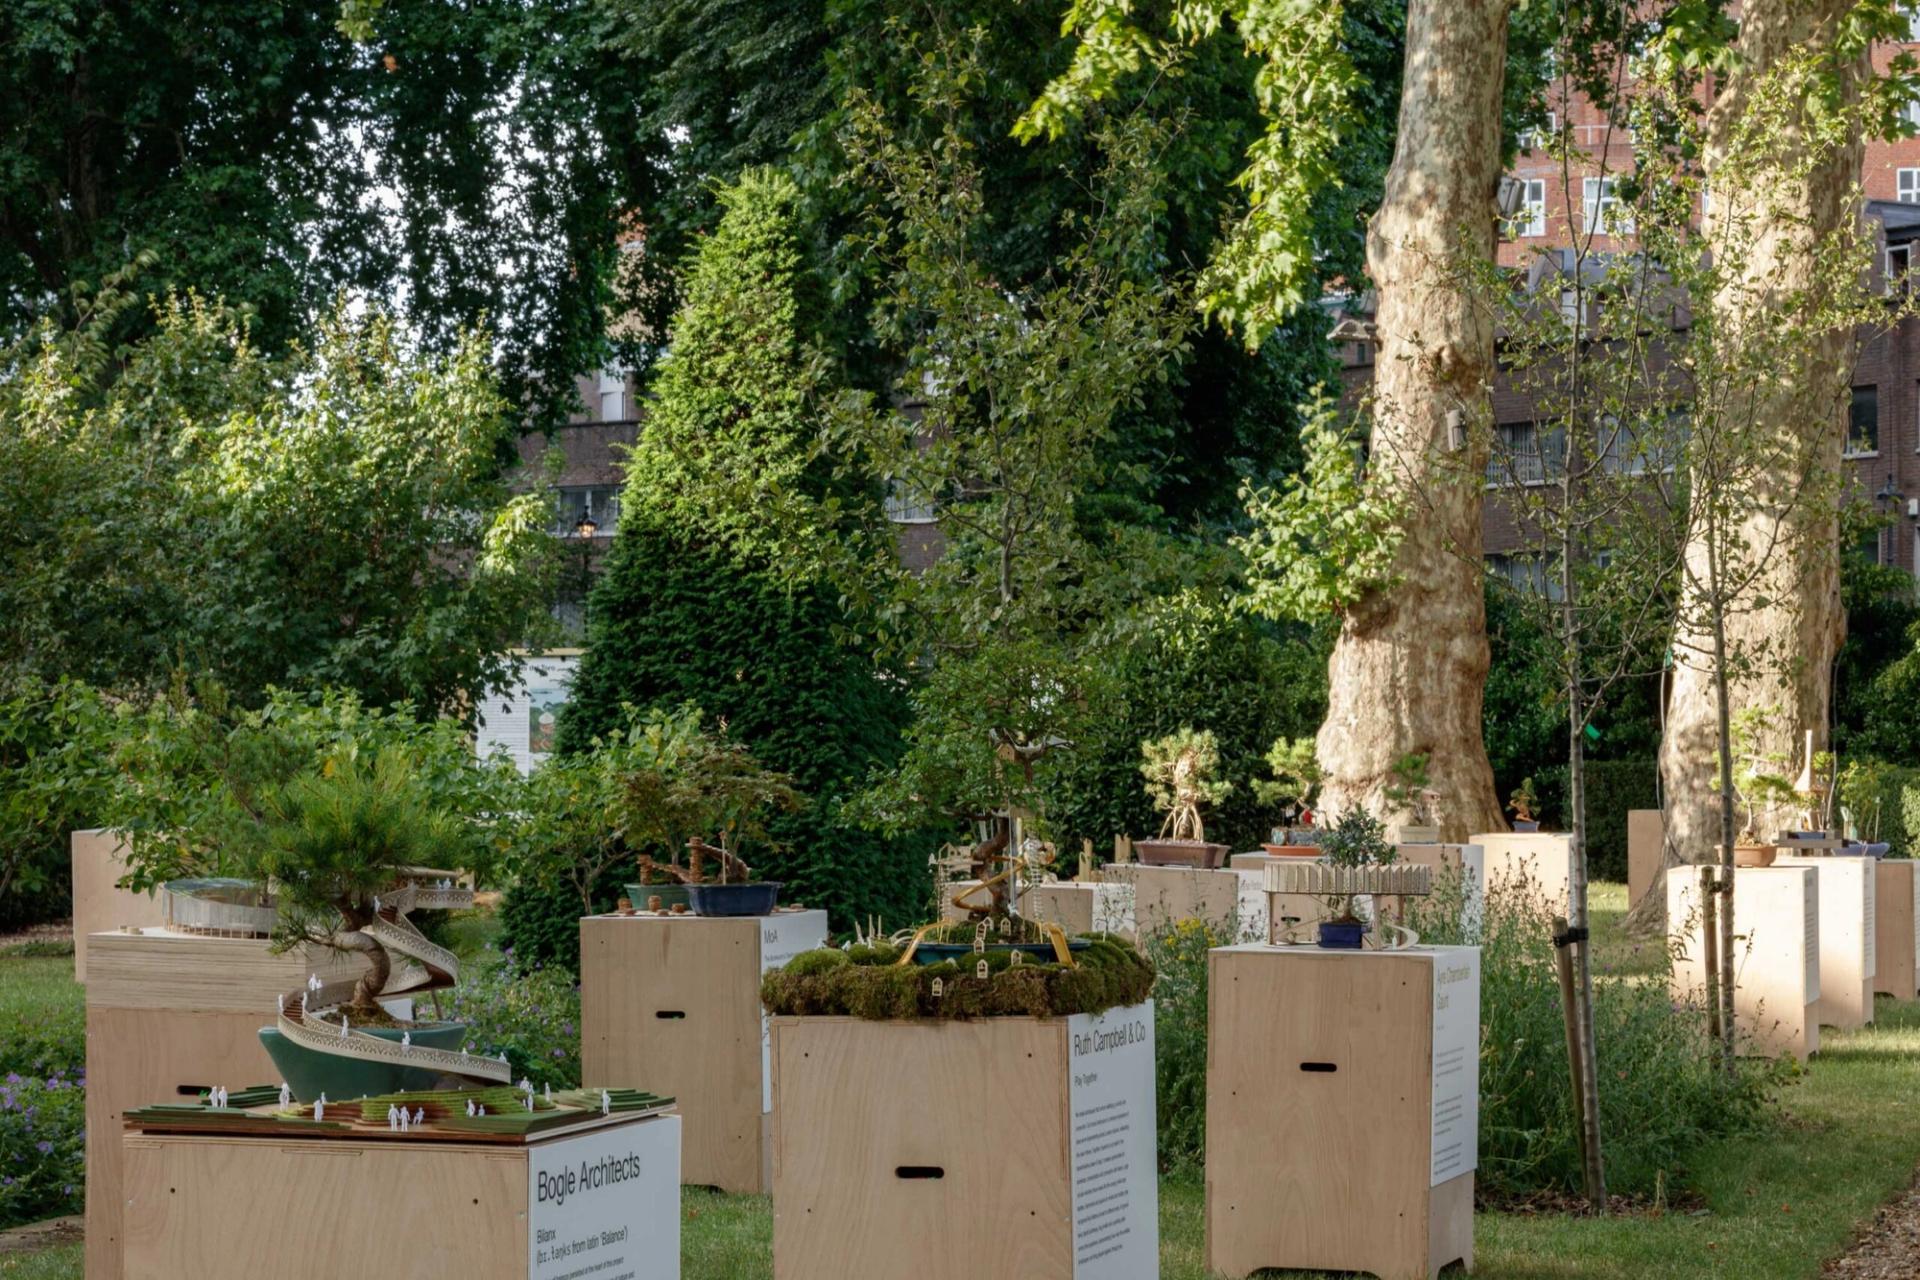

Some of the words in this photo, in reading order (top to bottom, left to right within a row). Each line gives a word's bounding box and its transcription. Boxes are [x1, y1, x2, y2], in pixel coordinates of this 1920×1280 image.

[764, 929, 778, 944] MoA
[1074, 1032, 1092, 1056] Ruth
[1093, 1024, 1127, 1054] Campbell
[1128, 1022, 1134, 1043] &
[1135, 1020, 1146, 1042] Co
[538, 1165, 576, 1206] Bogle
[579, 1151, 641, 1192] Architects
[572, 1239, 586, 1254] from
